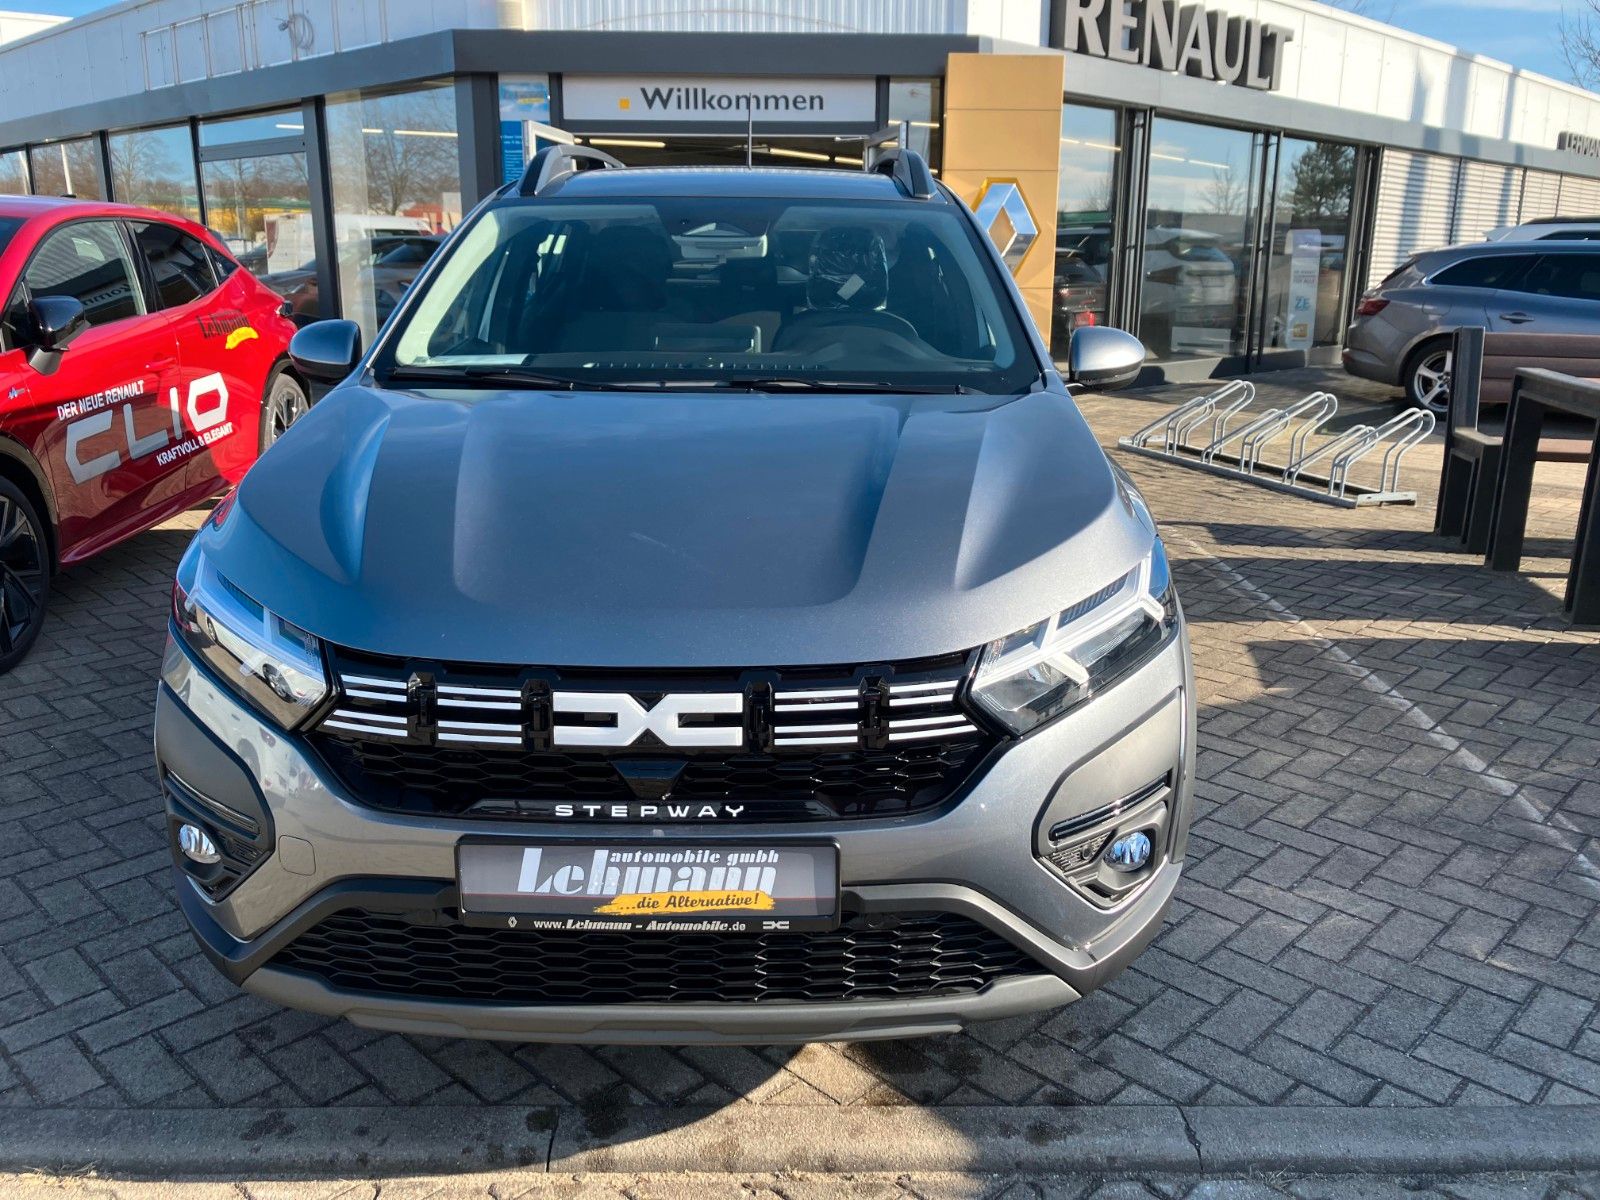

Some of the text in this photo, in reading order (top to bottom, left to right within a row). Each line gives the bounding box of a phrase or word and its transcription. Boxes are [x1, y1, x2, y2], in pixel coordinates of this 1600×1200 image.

[1050, 0, 1294, 91] RENAULT
[640, 87, 824, 110] Willkommen
[57, 380, 144, 421] DER NEUE RENAULT
[65, 372, 229, 485] CLIO
[156, 422, 233, 466] KRAFTVOLL & ELEGANT
[555, 805, 744, 817] STEPWAY
[517, 848, 777, 895] Lehmann
[610, 850, 779, 866] automobile gmbh
[665, 893, 759, 909] Alternative!
